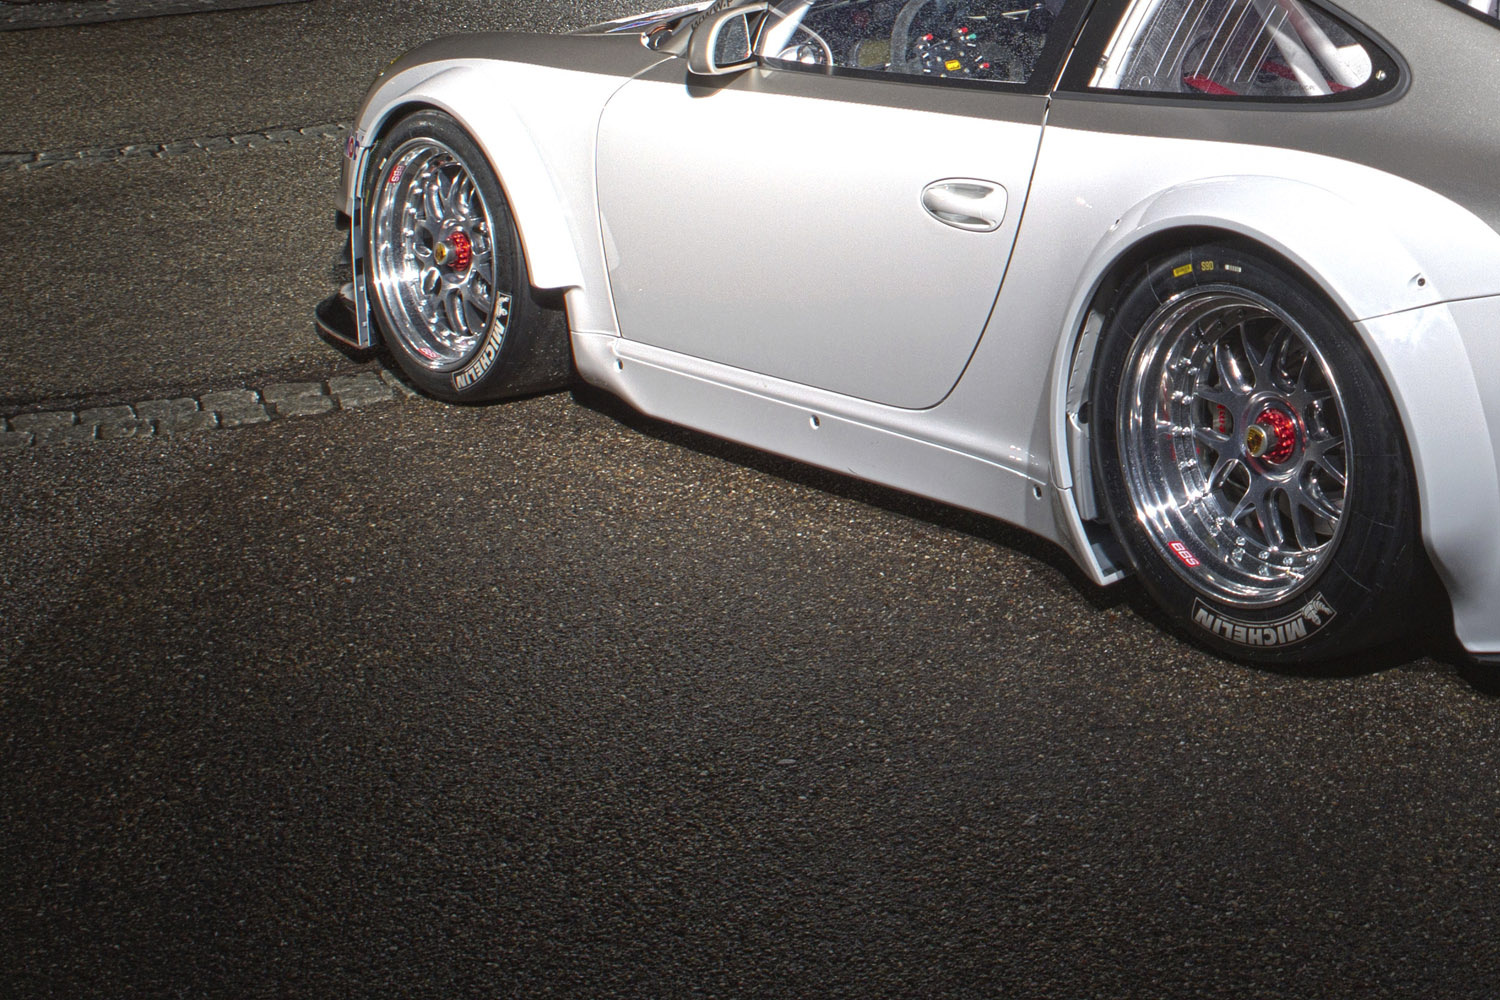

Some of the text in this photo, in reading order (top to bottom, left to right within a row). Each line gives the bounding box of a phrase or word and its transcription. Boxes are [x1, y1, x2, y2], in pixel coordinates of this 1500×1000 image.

[456, 319, 505, 388] MICHELIN
[1171, 542, 1199, 566] BBS
[1195, 607, 1308, 646] MICHELIN
